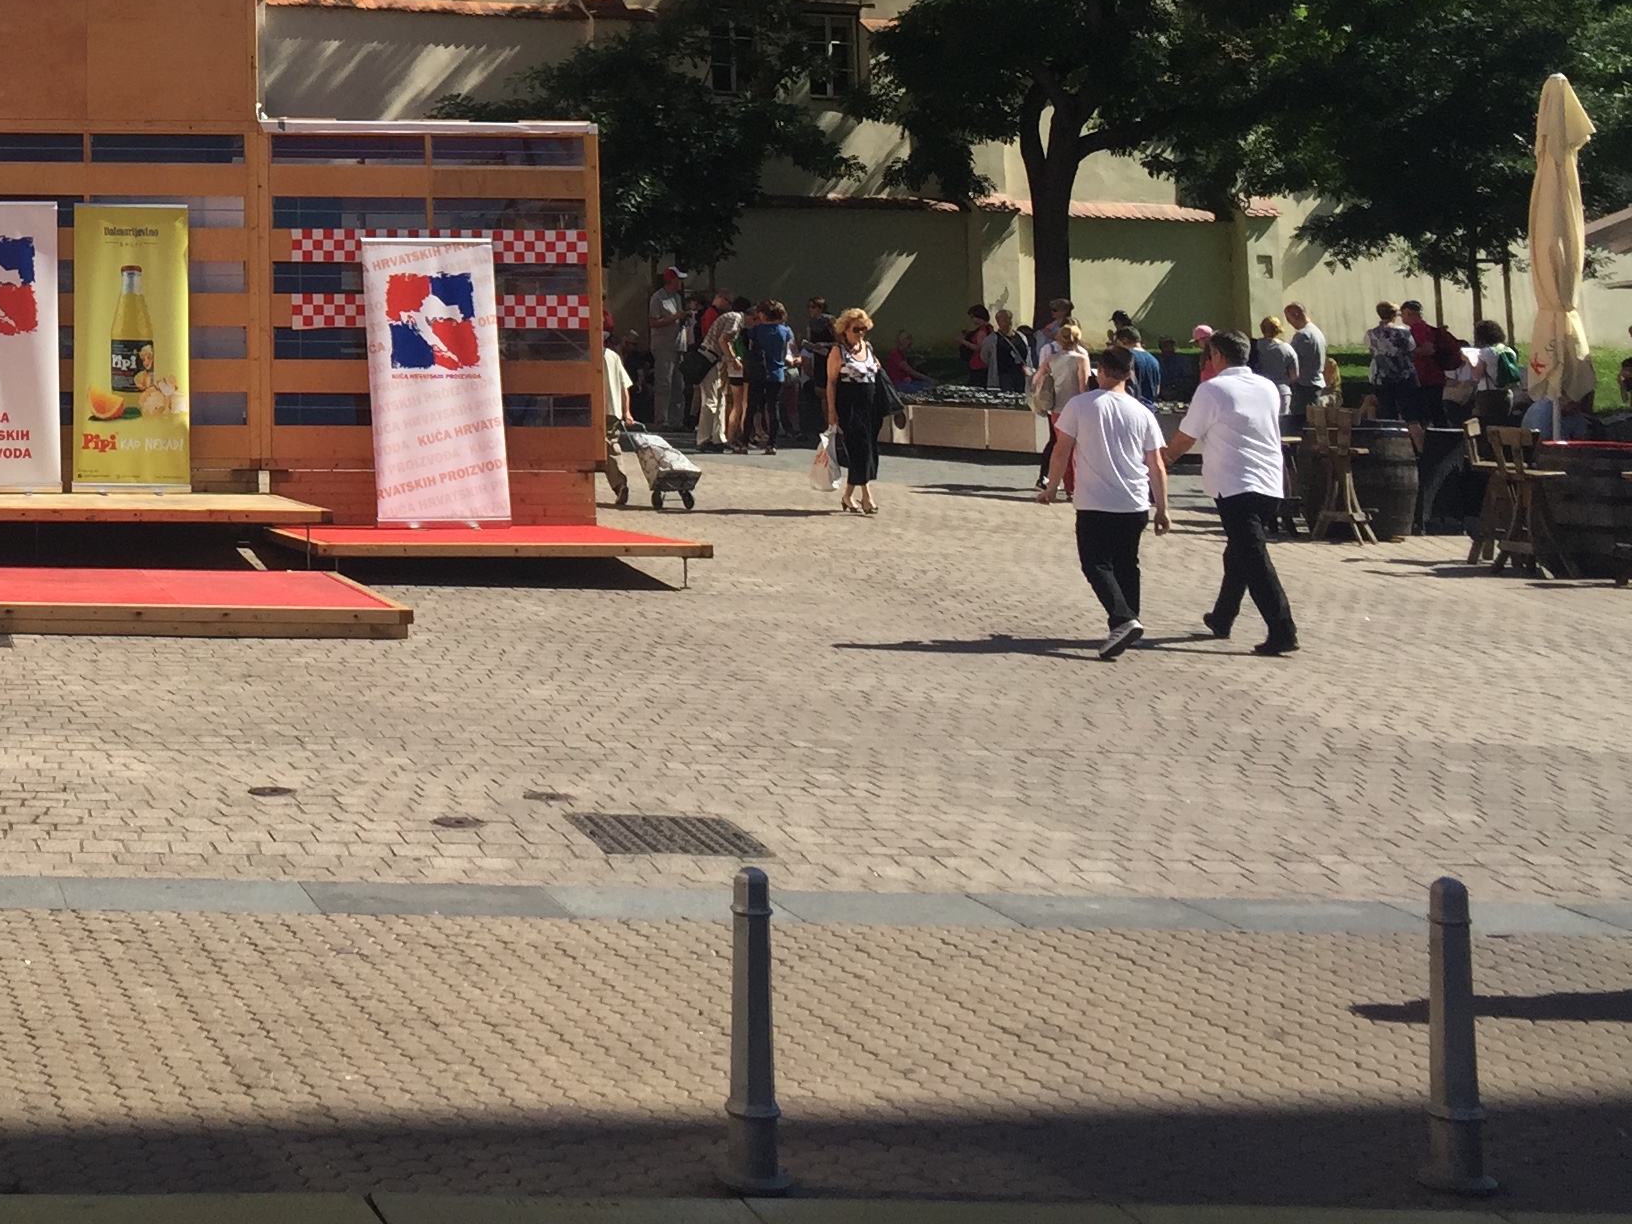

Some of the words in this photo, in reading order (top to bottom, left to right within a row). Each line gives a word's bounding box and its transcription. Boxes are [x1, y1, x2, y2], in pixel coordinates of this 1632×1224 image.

[372, 246, 441, 272] HRVATSKIH
[82, 431, 117, 453] Pipi
[417, 429, 452, 447] KUĆA
